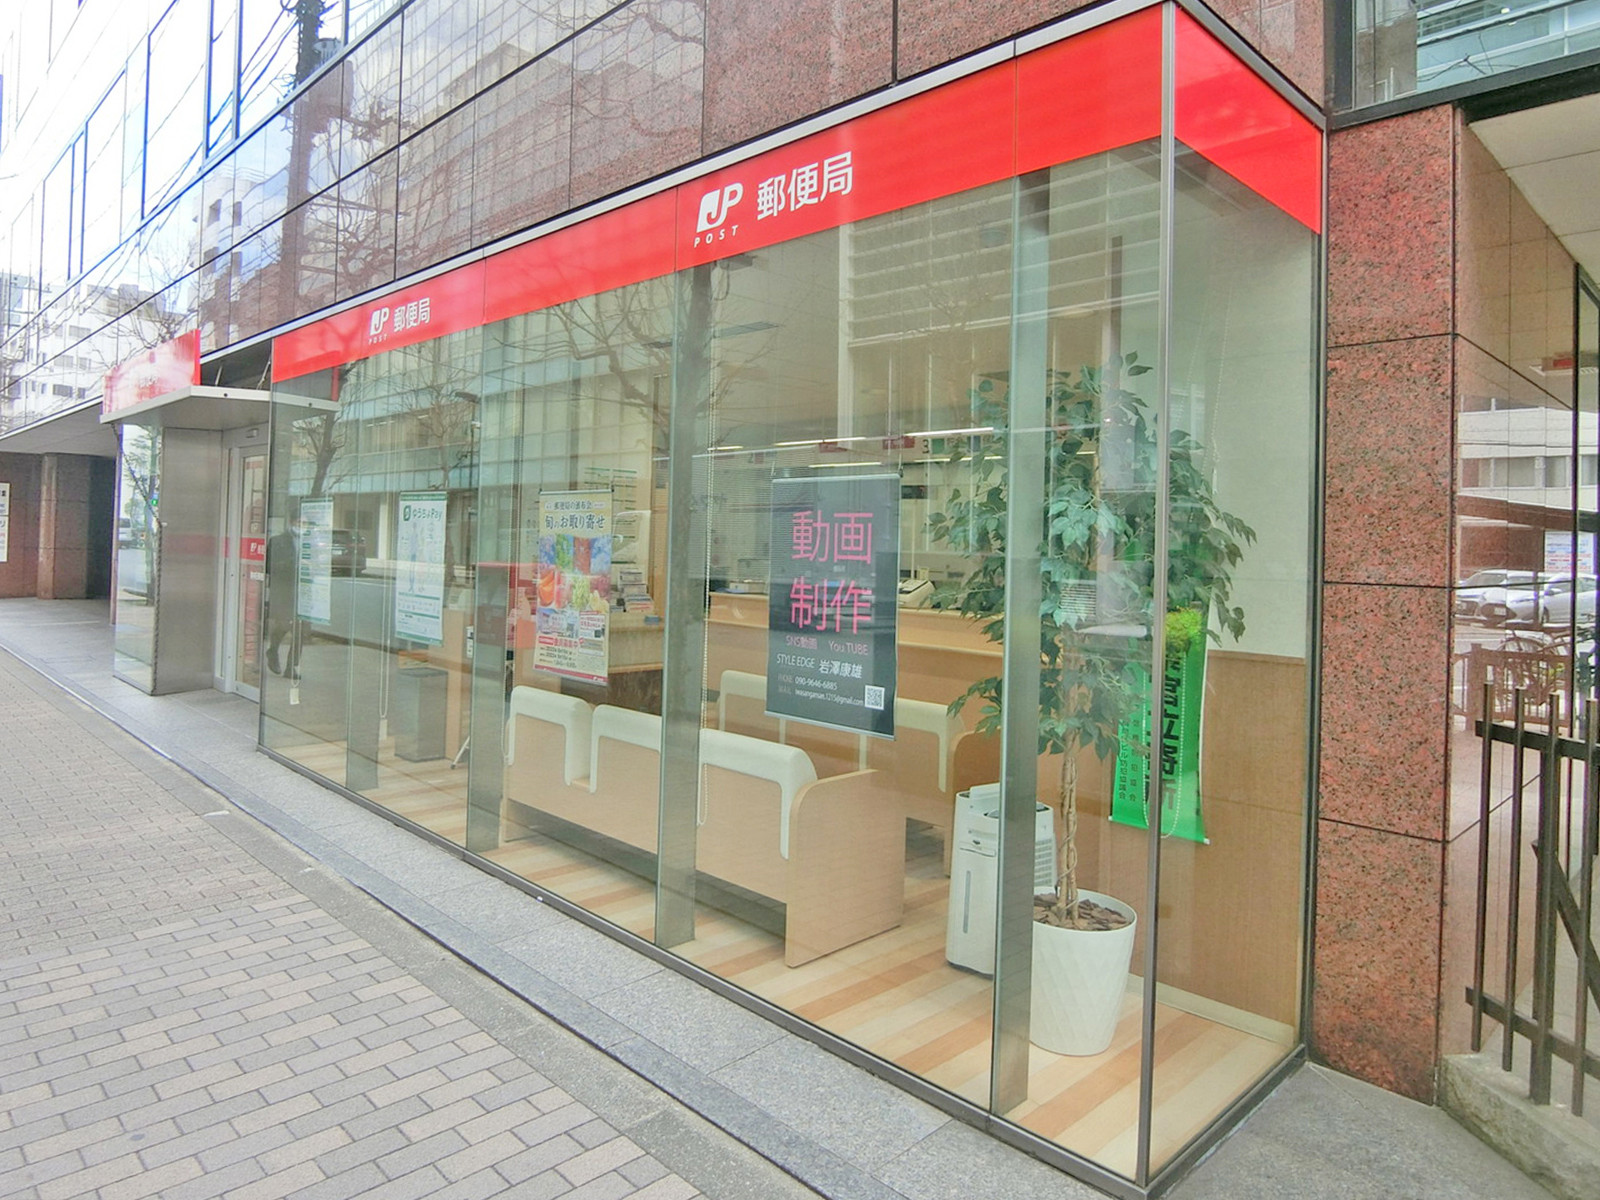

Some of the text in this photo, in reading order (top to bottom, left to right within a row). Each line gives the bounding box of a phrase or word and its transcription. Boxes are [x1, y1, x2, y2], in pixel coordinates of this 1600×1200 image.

[757, 151, 853, 220] 郵便局
[693, 225, 739, 248] POST
[394, 297, 430, 332] 郵便局
[545, 514, 605, 530] 旬のお取り寄せ
[792, 510, 874, 564] 動画
[790, 576, 872, 634] 制作
[777, 653, 815, 668] STYLE EDGE
